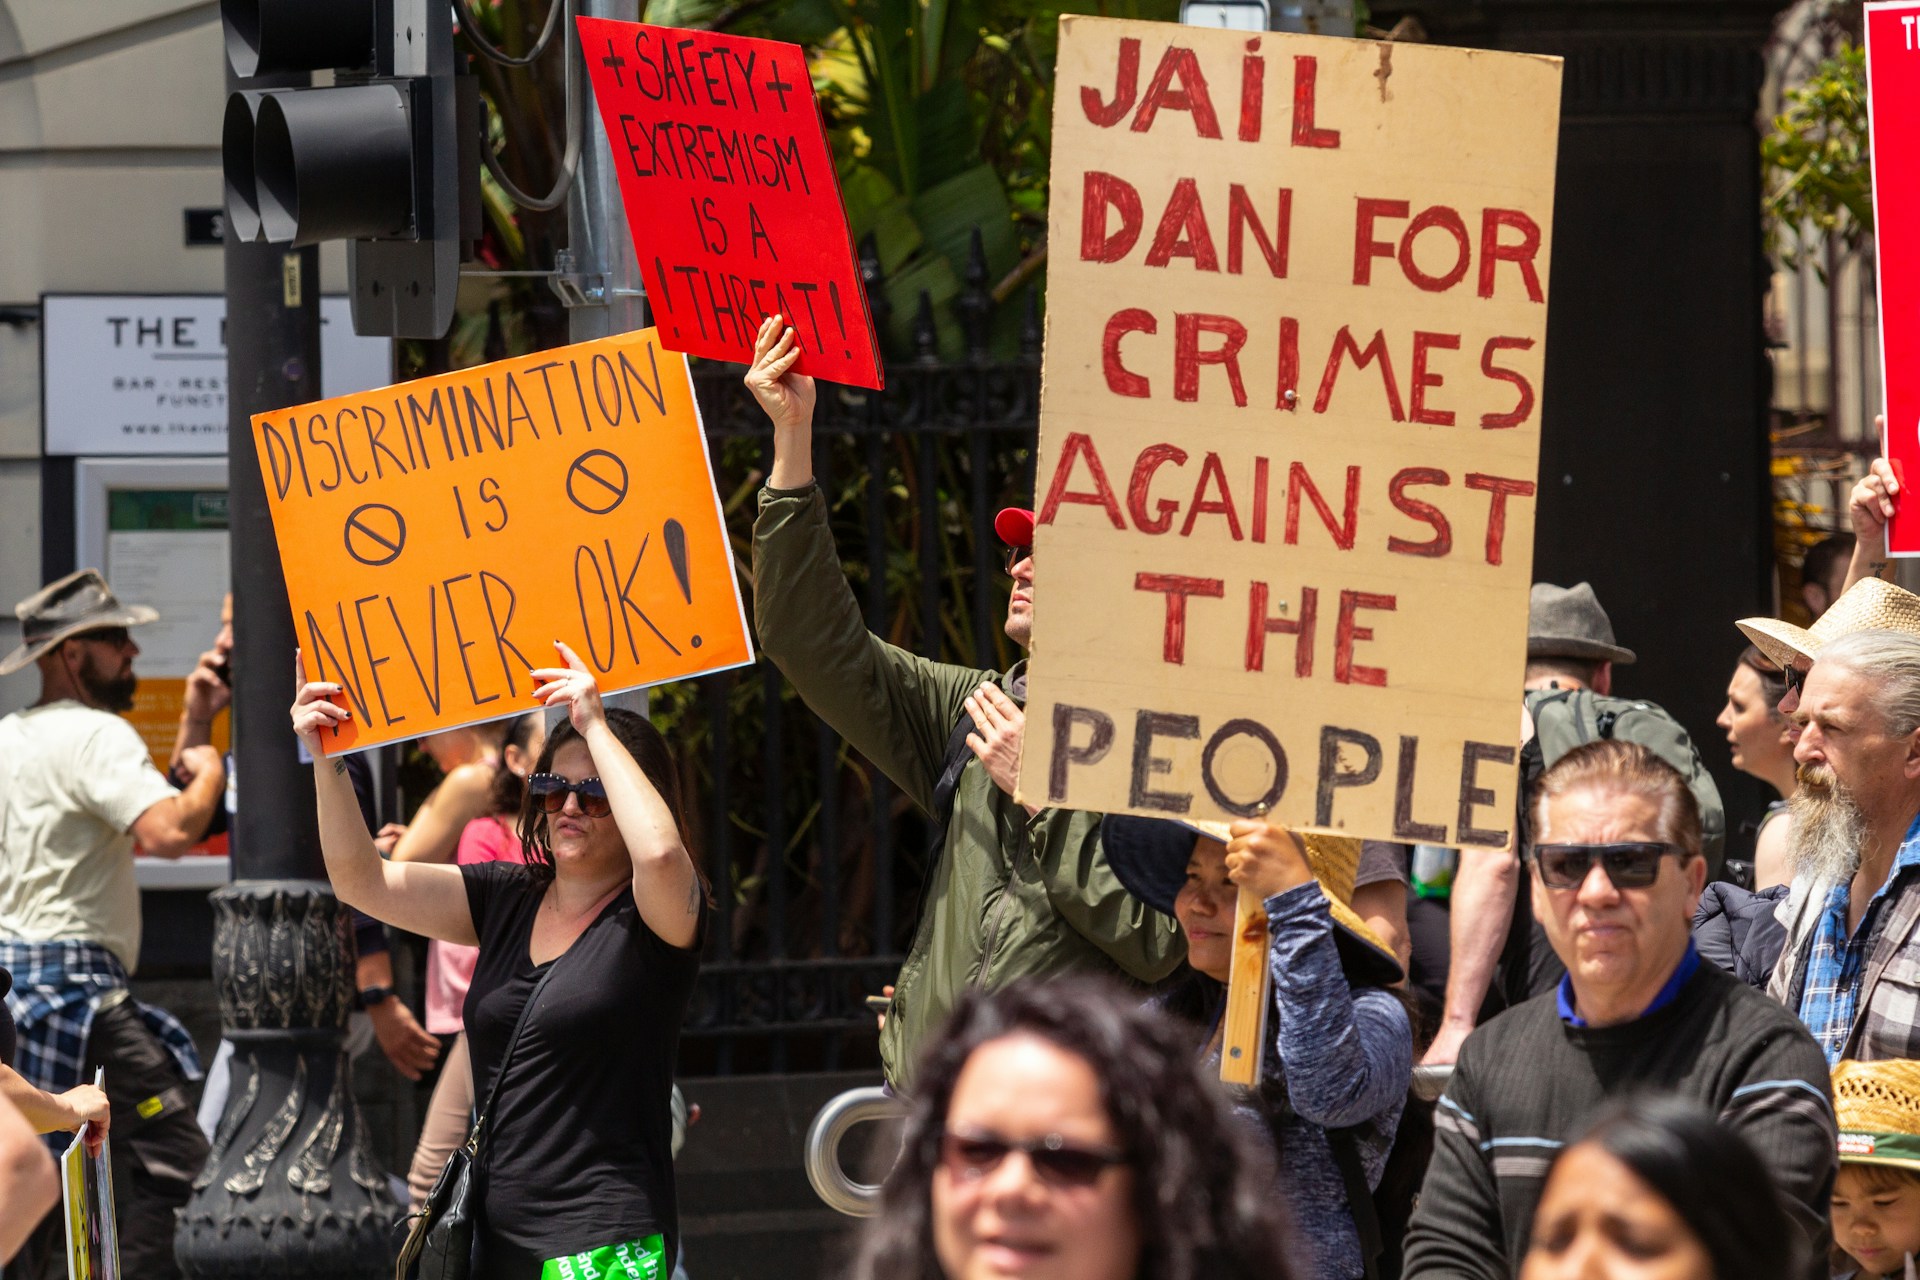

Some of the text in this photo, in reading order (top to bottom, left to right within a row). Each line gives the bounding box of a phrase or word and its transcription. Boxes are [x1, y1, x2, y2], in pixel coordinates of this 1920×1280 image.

[619, 113, 811, 196] EXTREMISM
[690, 196, 779, 262] IS A
[1080, 170, 1545, 304] DAN FOR
[106, 317, 197, 347] THE
[113, 377, 155, 389] BAR
[1103, 307, 1537, 429] CRIMES
[262, 341, 667, 502] DISCRIMINATION
[453, 477, 510, 539] IS
[1036, 432, 1535, 566] AGAINST
[305, 518, 704, 736] NEVER OK!
[1134, 571, 1397, 687] THE
[1047, 702, 1516, 847] PEOPLE
